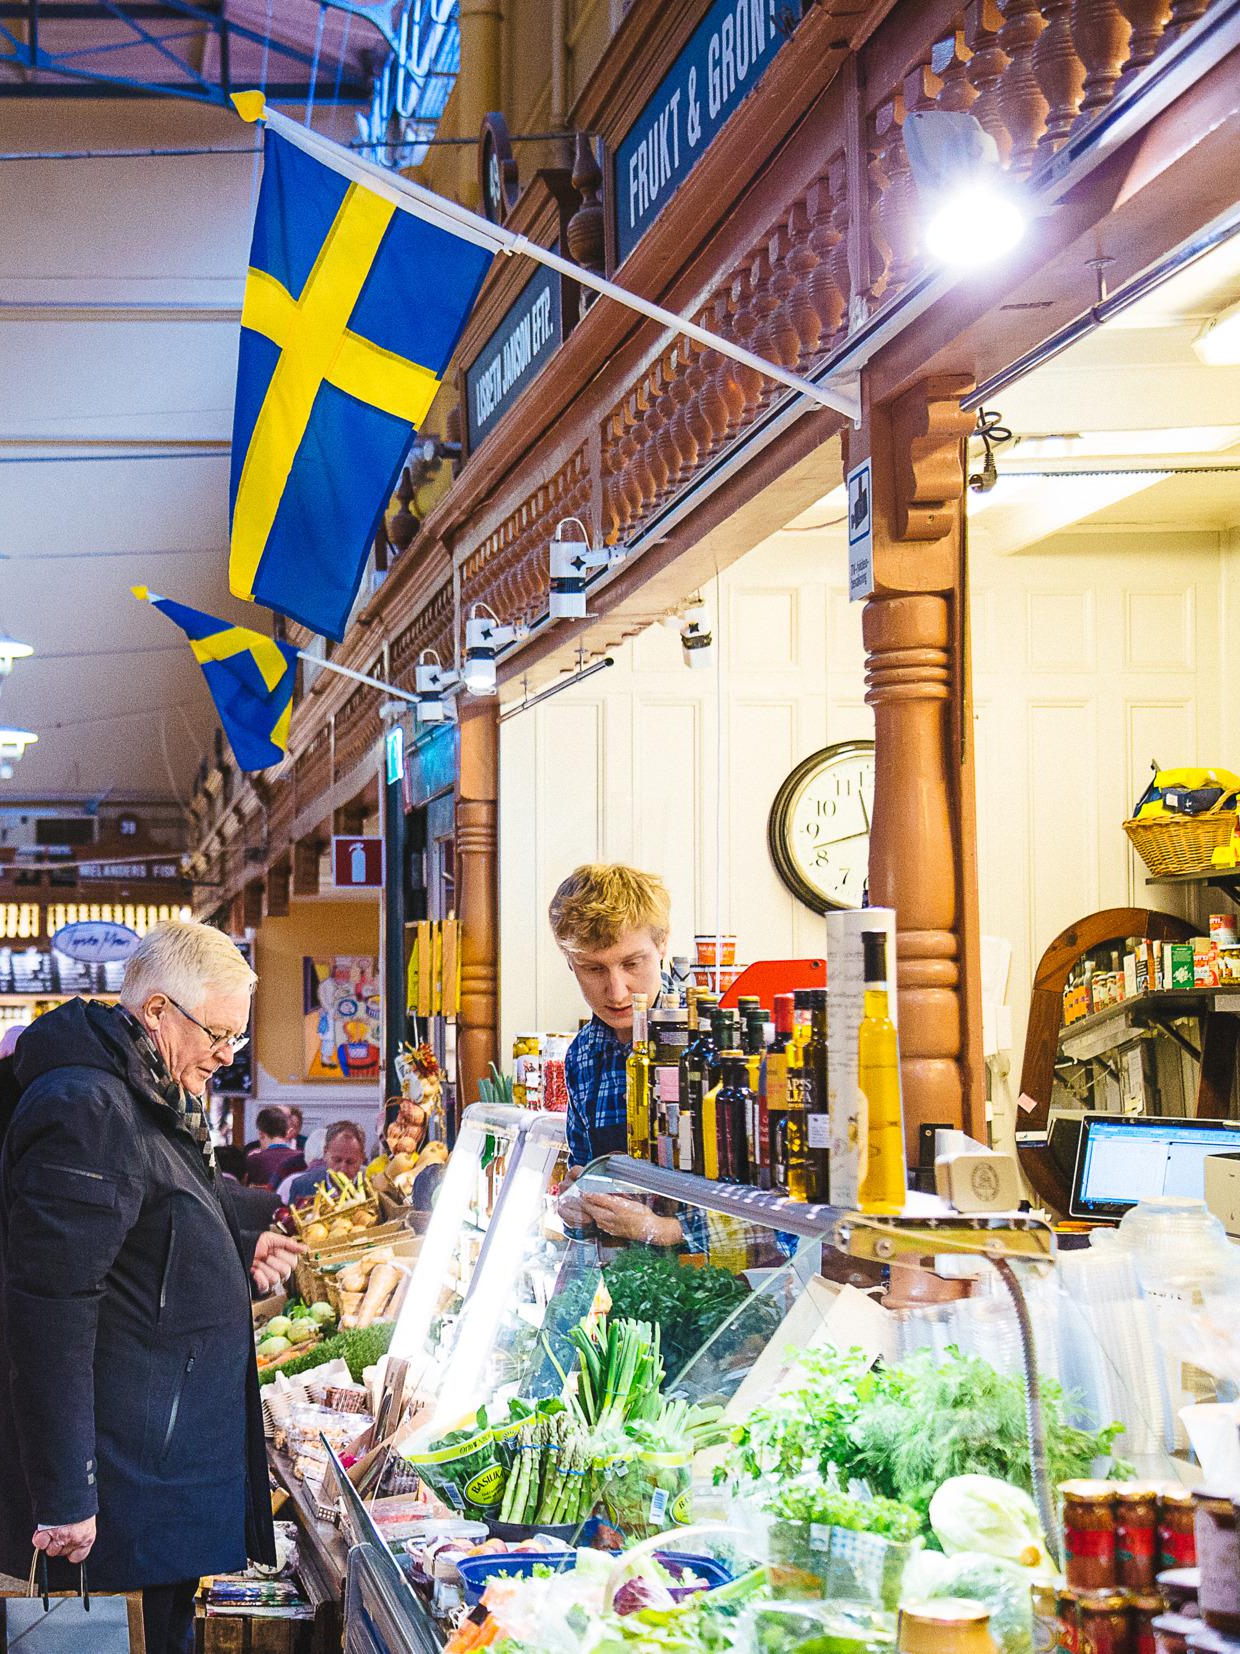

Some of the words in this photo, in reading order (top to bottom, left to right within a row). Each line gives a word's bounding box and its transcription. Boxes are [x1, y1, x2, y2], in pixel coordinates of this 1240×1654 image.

[630, 88, 680, 228] FRUKT
[688, 66, 702, 147] &
[837, 780, 850, 796] 11
[817, 800, 836, 817] 10
[806, 822, 820, 840] 9
[815, 850, 829, 867] 8
[839, 868, 850, 885] 7
